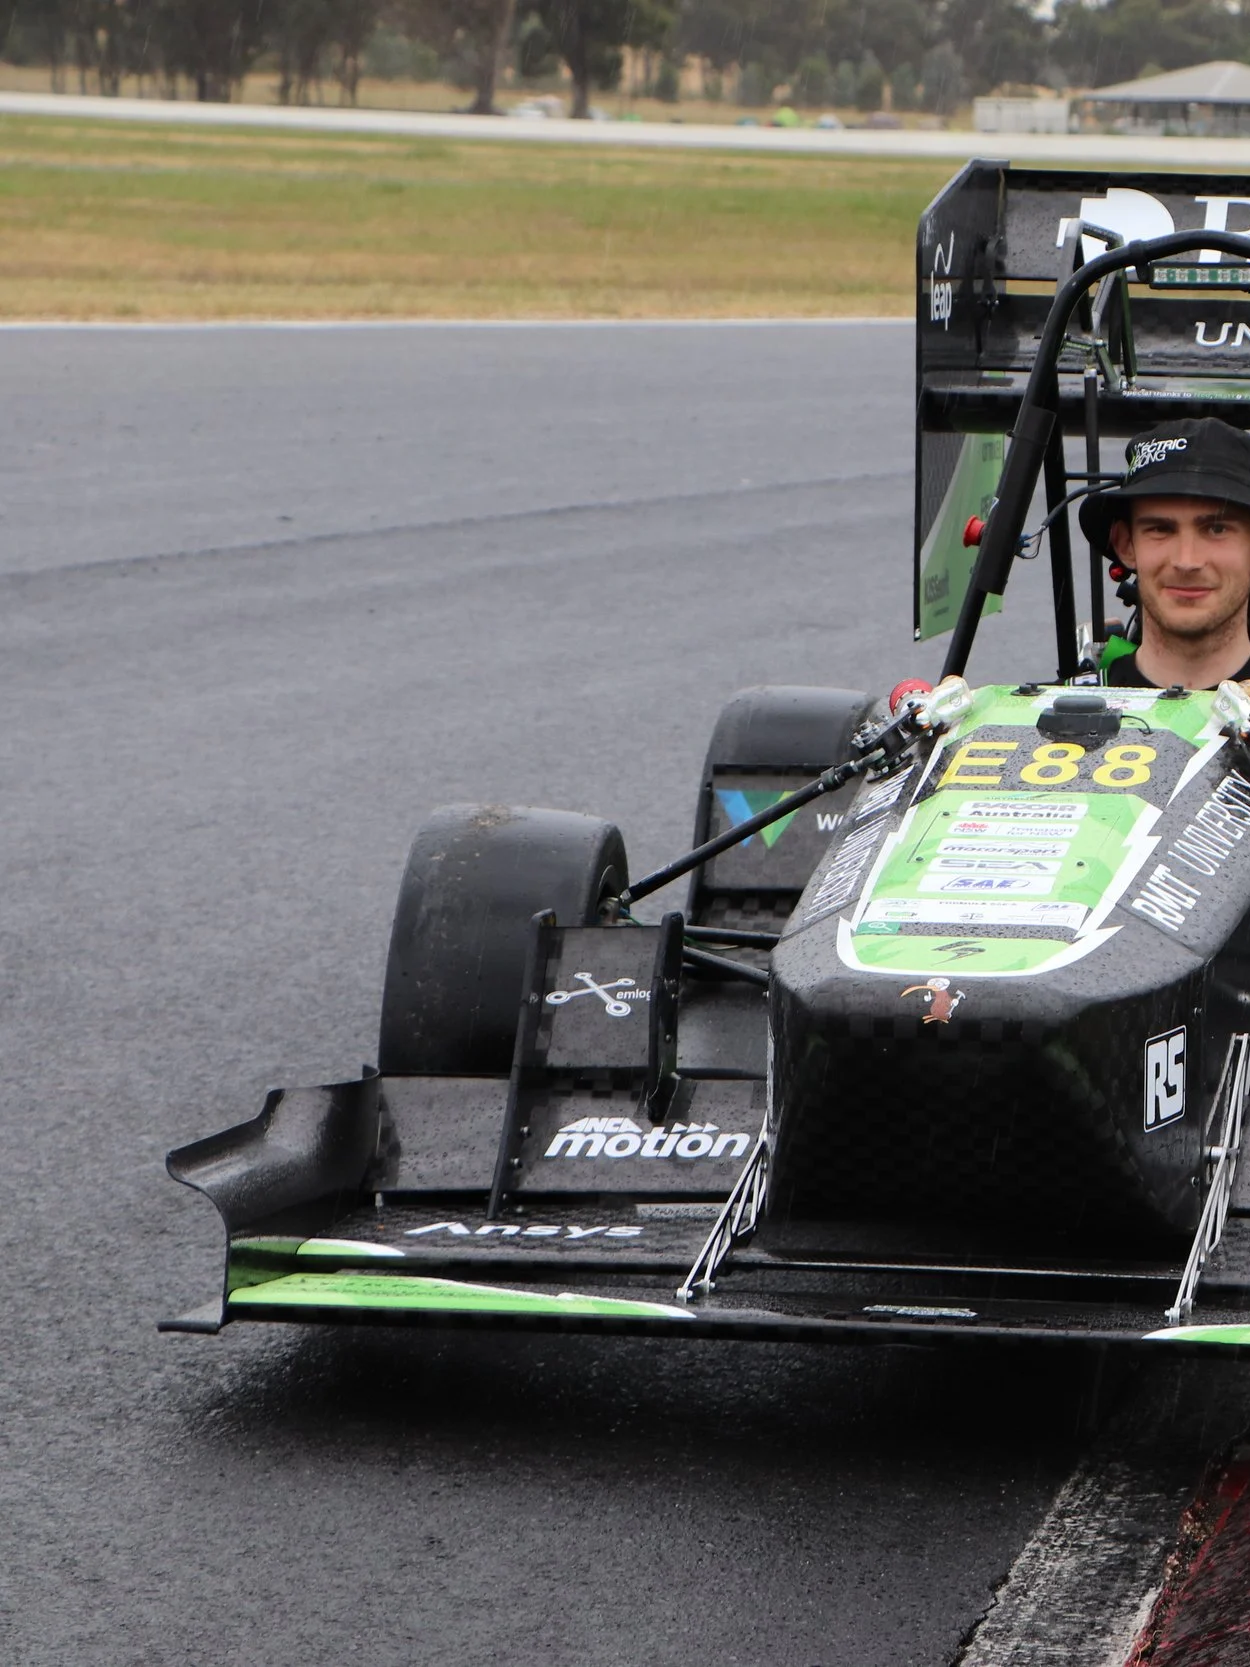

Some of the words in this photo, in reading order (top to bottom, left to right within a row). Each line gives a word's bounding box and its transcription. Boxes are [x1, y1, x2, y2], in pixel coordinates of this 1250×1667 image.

[931, 270, 953, 332] leap
[937, 740, 1157, 788] E88
[969, 811, 1073, 819] Australia
[1131, 863, 1202, 932] RMIT
[616, 989, 651, 1001] emlog
[558, 1117, 643, 1133] ANCA
[543, 1122, 751, 1157] motion
[403, 1221, 645, 1239] Ansys
